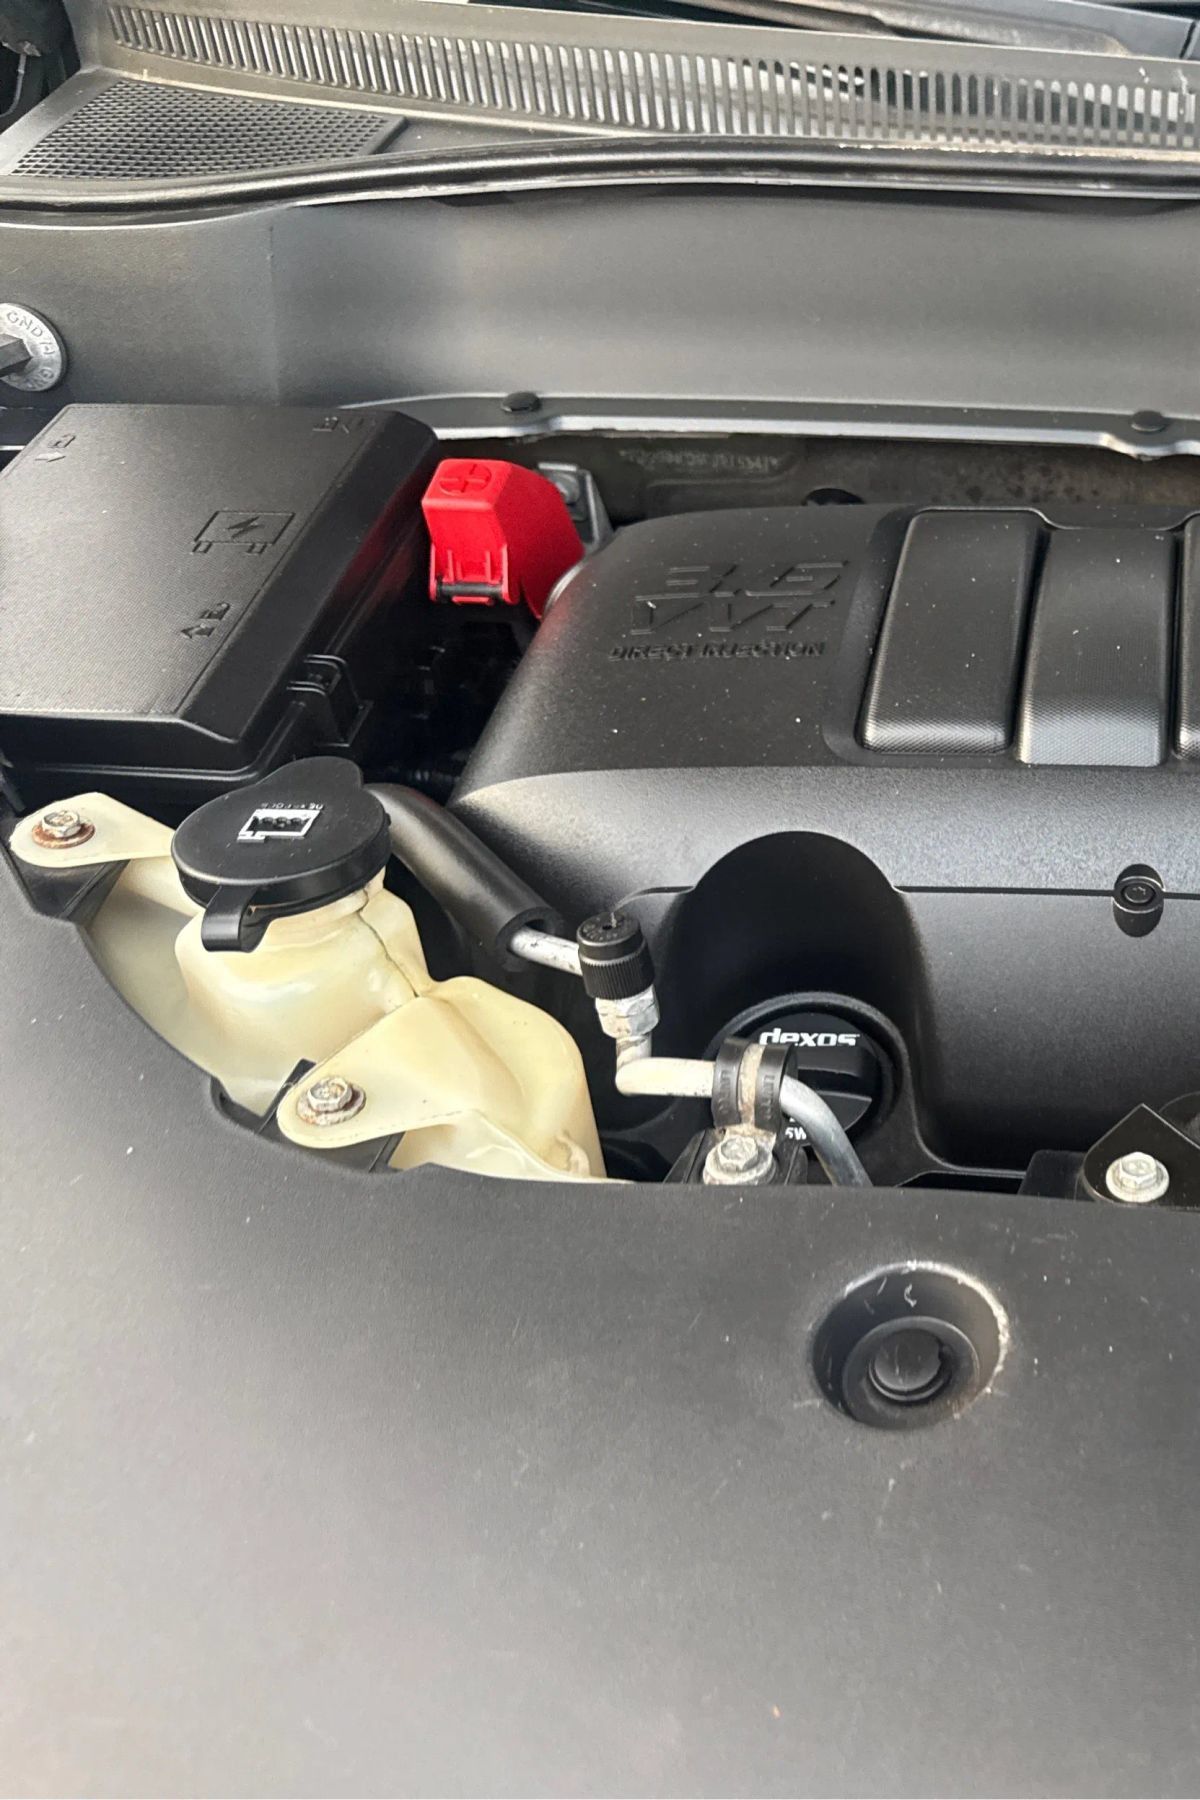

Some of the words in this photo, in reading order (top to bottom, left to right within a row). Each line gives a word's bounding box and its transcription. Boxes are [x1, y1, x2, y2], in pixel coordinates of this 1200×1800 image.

[6, 311, 43, 337] GND
[609, 642, 694, 662] DIRECT
[699, 640, 827, 660] INJECTION
[759, 1028, 859, 1047] dexos
